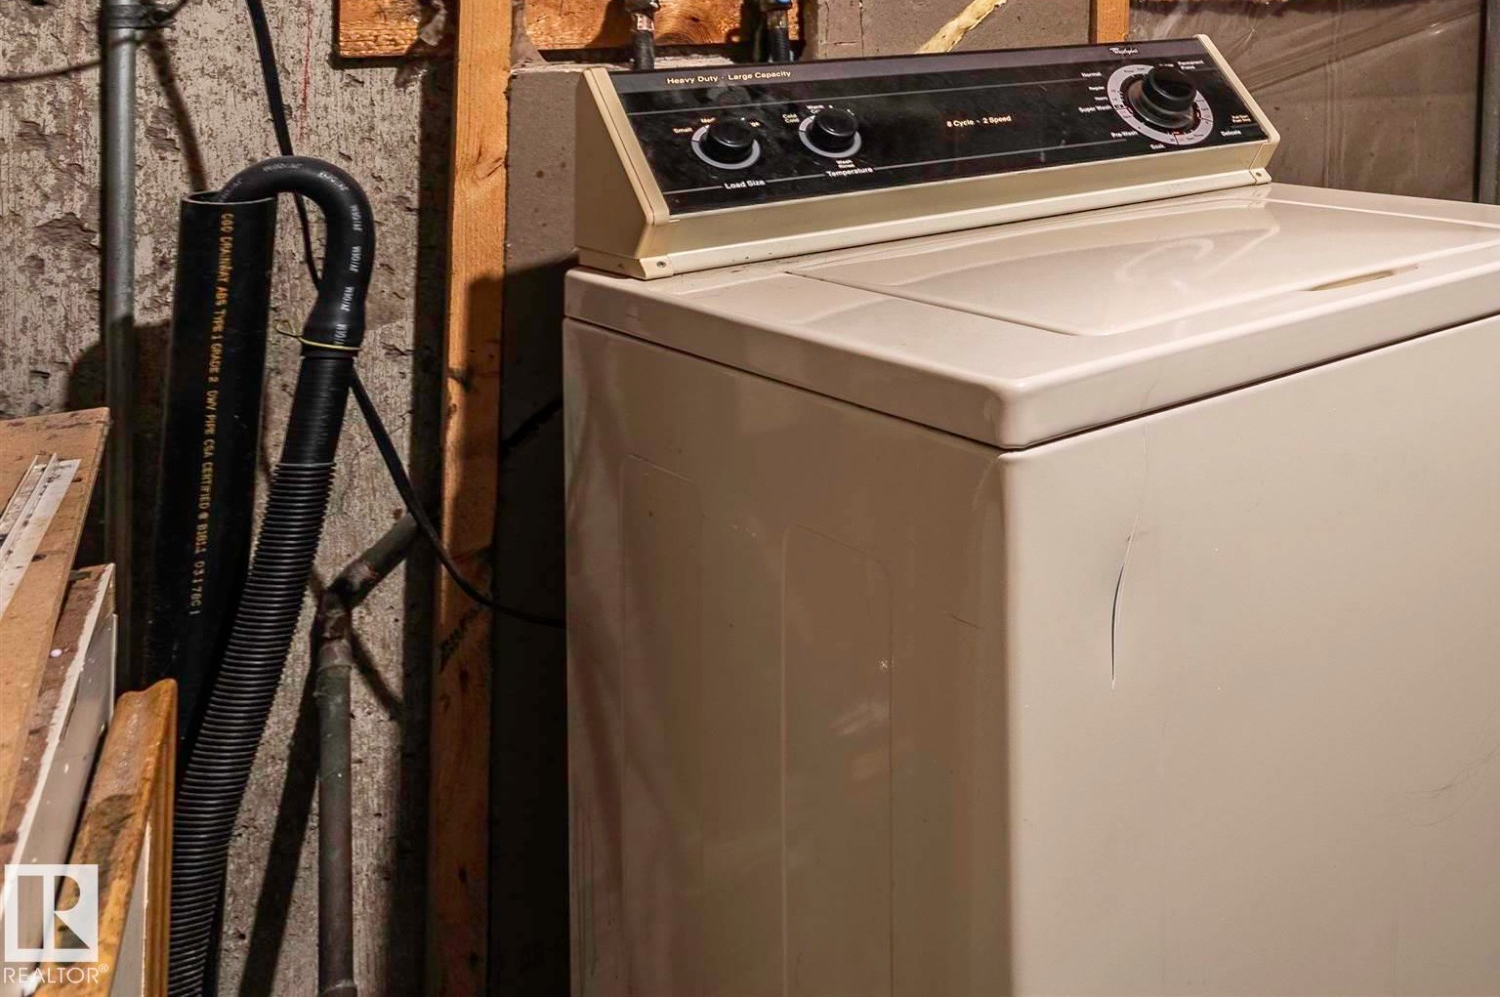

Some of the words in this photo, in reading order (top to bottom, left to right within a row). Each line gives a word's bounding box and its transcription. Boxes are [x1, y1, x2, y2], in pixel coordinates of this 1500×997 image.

[1109, 47, 1139, 55] Whirlpool
[666, 77, 695, 85] Heavy
[697, 75, 718, 83] Duty
[728, 73, 753, 81] Large
[755, 70, 792, 80] Capacity
[953, 119, 975, 128] Cycle
[989, 115, 1012, 125] Speed
[826, 167, 874, 178] Temperature
[724, 182, 747, 190] Load
[747, 180, 767, 188] Size
[212, 308, 228, 332] TYPE
[208, 343, 223, 373] GRADE
[203, 414, 218, 435] PIPE
[203, 438, 215, 458] CSA
[198, 461, 214, 510] CERTIFIED
